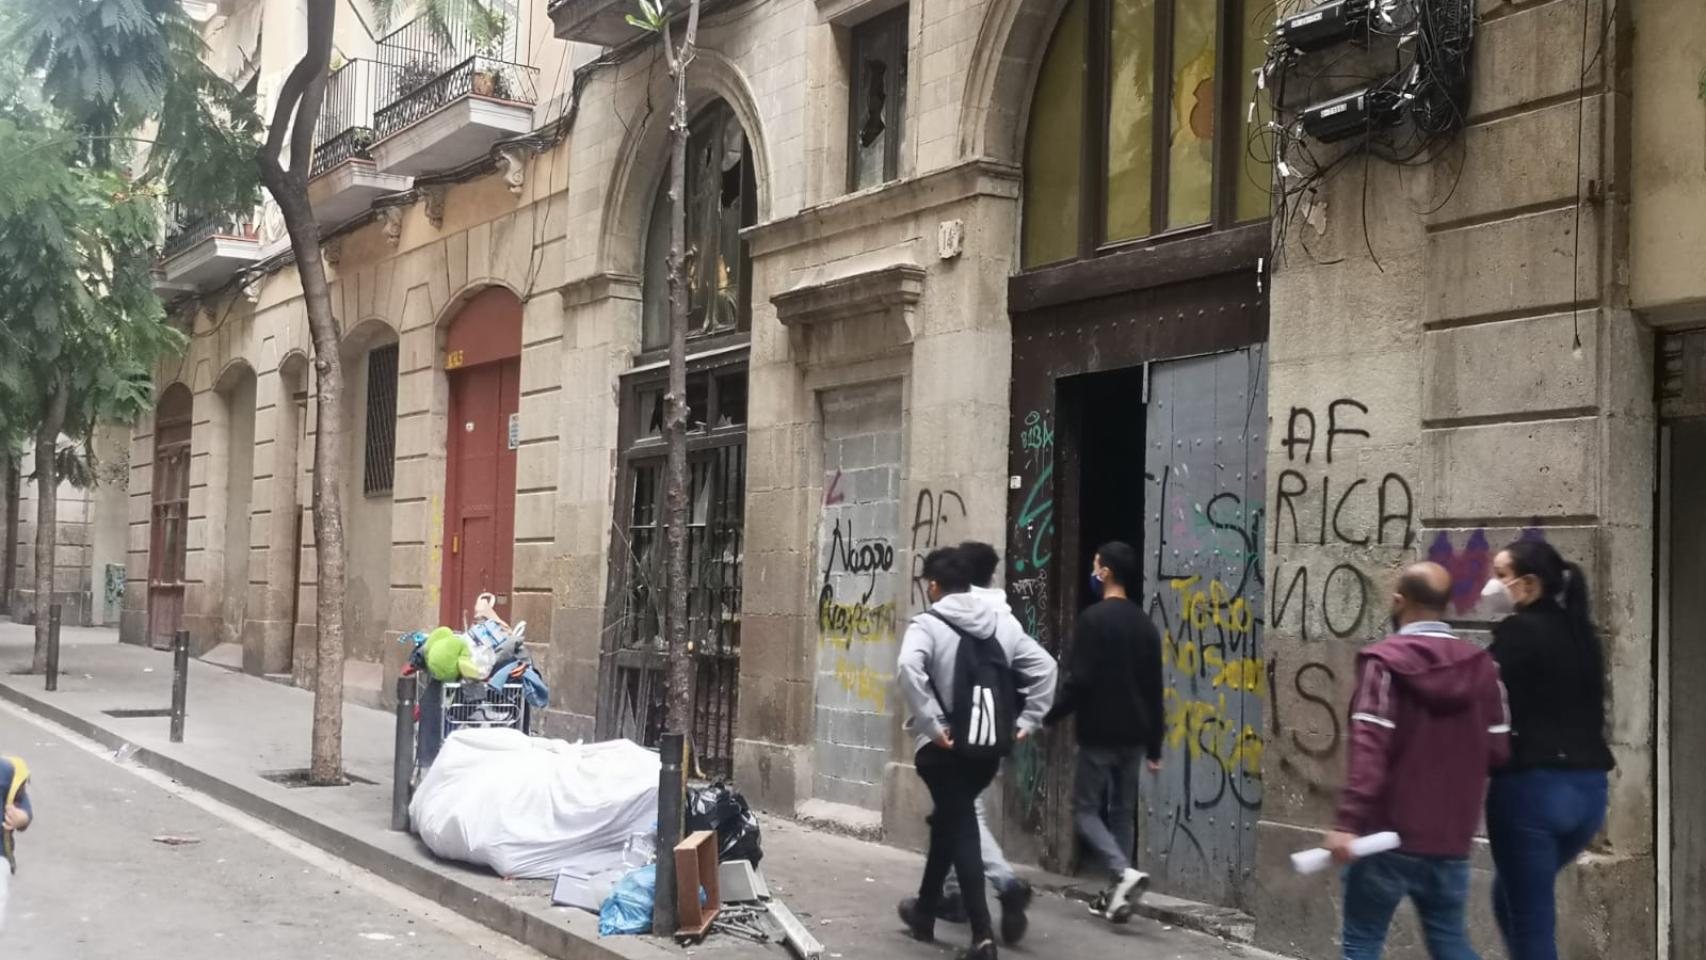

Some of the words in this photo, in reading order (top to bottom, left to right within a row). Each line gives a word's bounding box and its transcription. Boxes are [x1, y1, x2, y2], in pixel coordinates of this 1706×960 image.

[1281, 398, 1370, 464] AF
[1273, 468, 1414, 555] RICA
[1271, 563, 1367, 640] NO
[1267, 657, 1341, 760] IS
